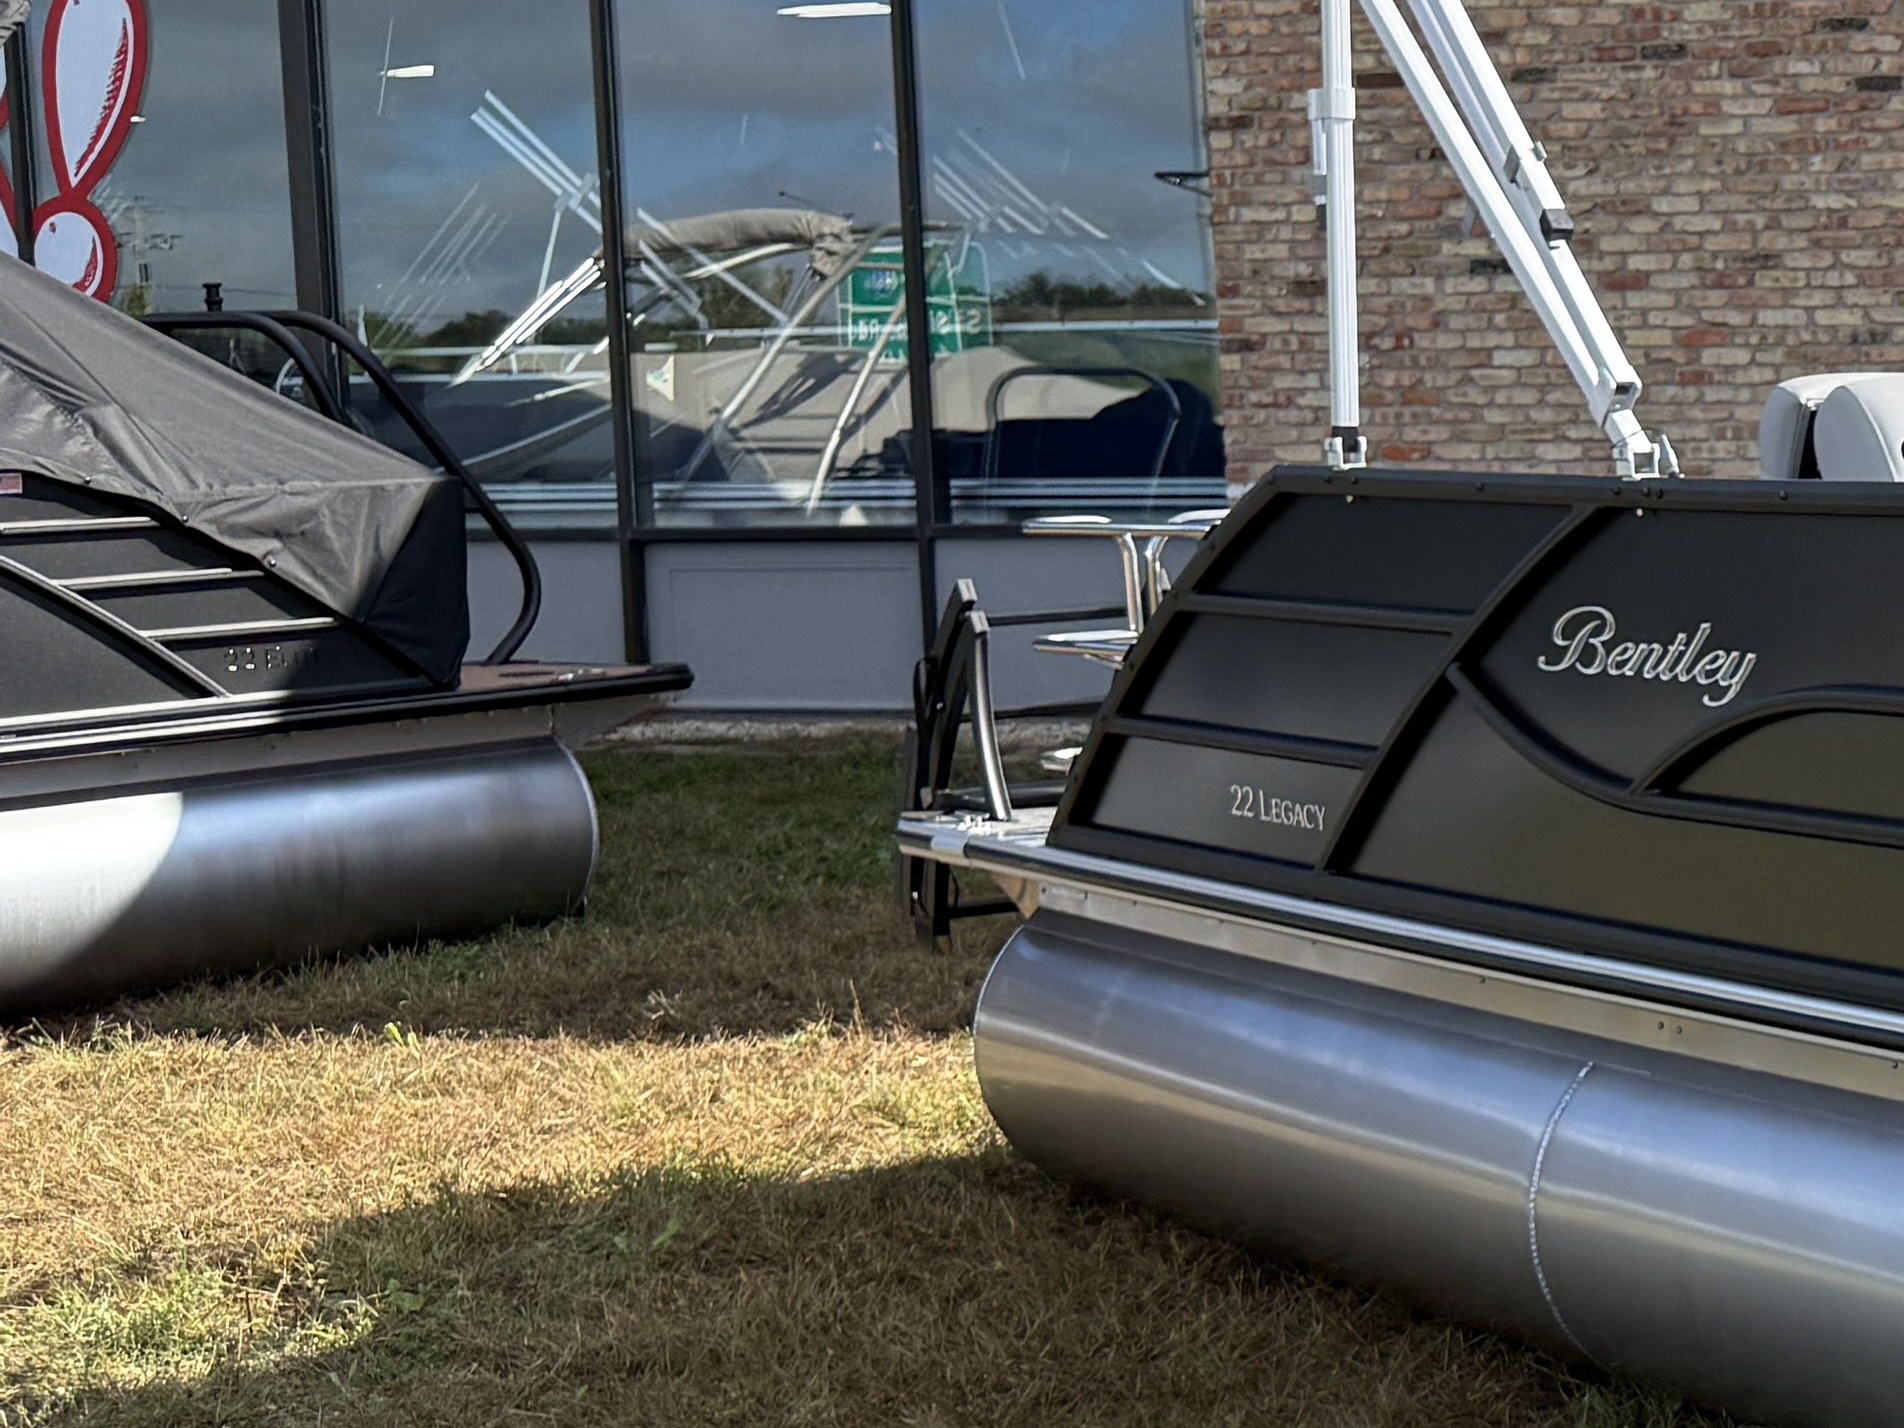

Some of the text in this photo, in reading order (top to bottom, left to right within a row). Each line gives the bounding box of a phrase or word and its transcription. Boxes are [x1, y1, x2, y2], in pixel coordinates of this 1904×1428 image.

[1537, 605, 1758, 707] Bentley
[1230, 784, 1326, 831] 22 LEGACY
